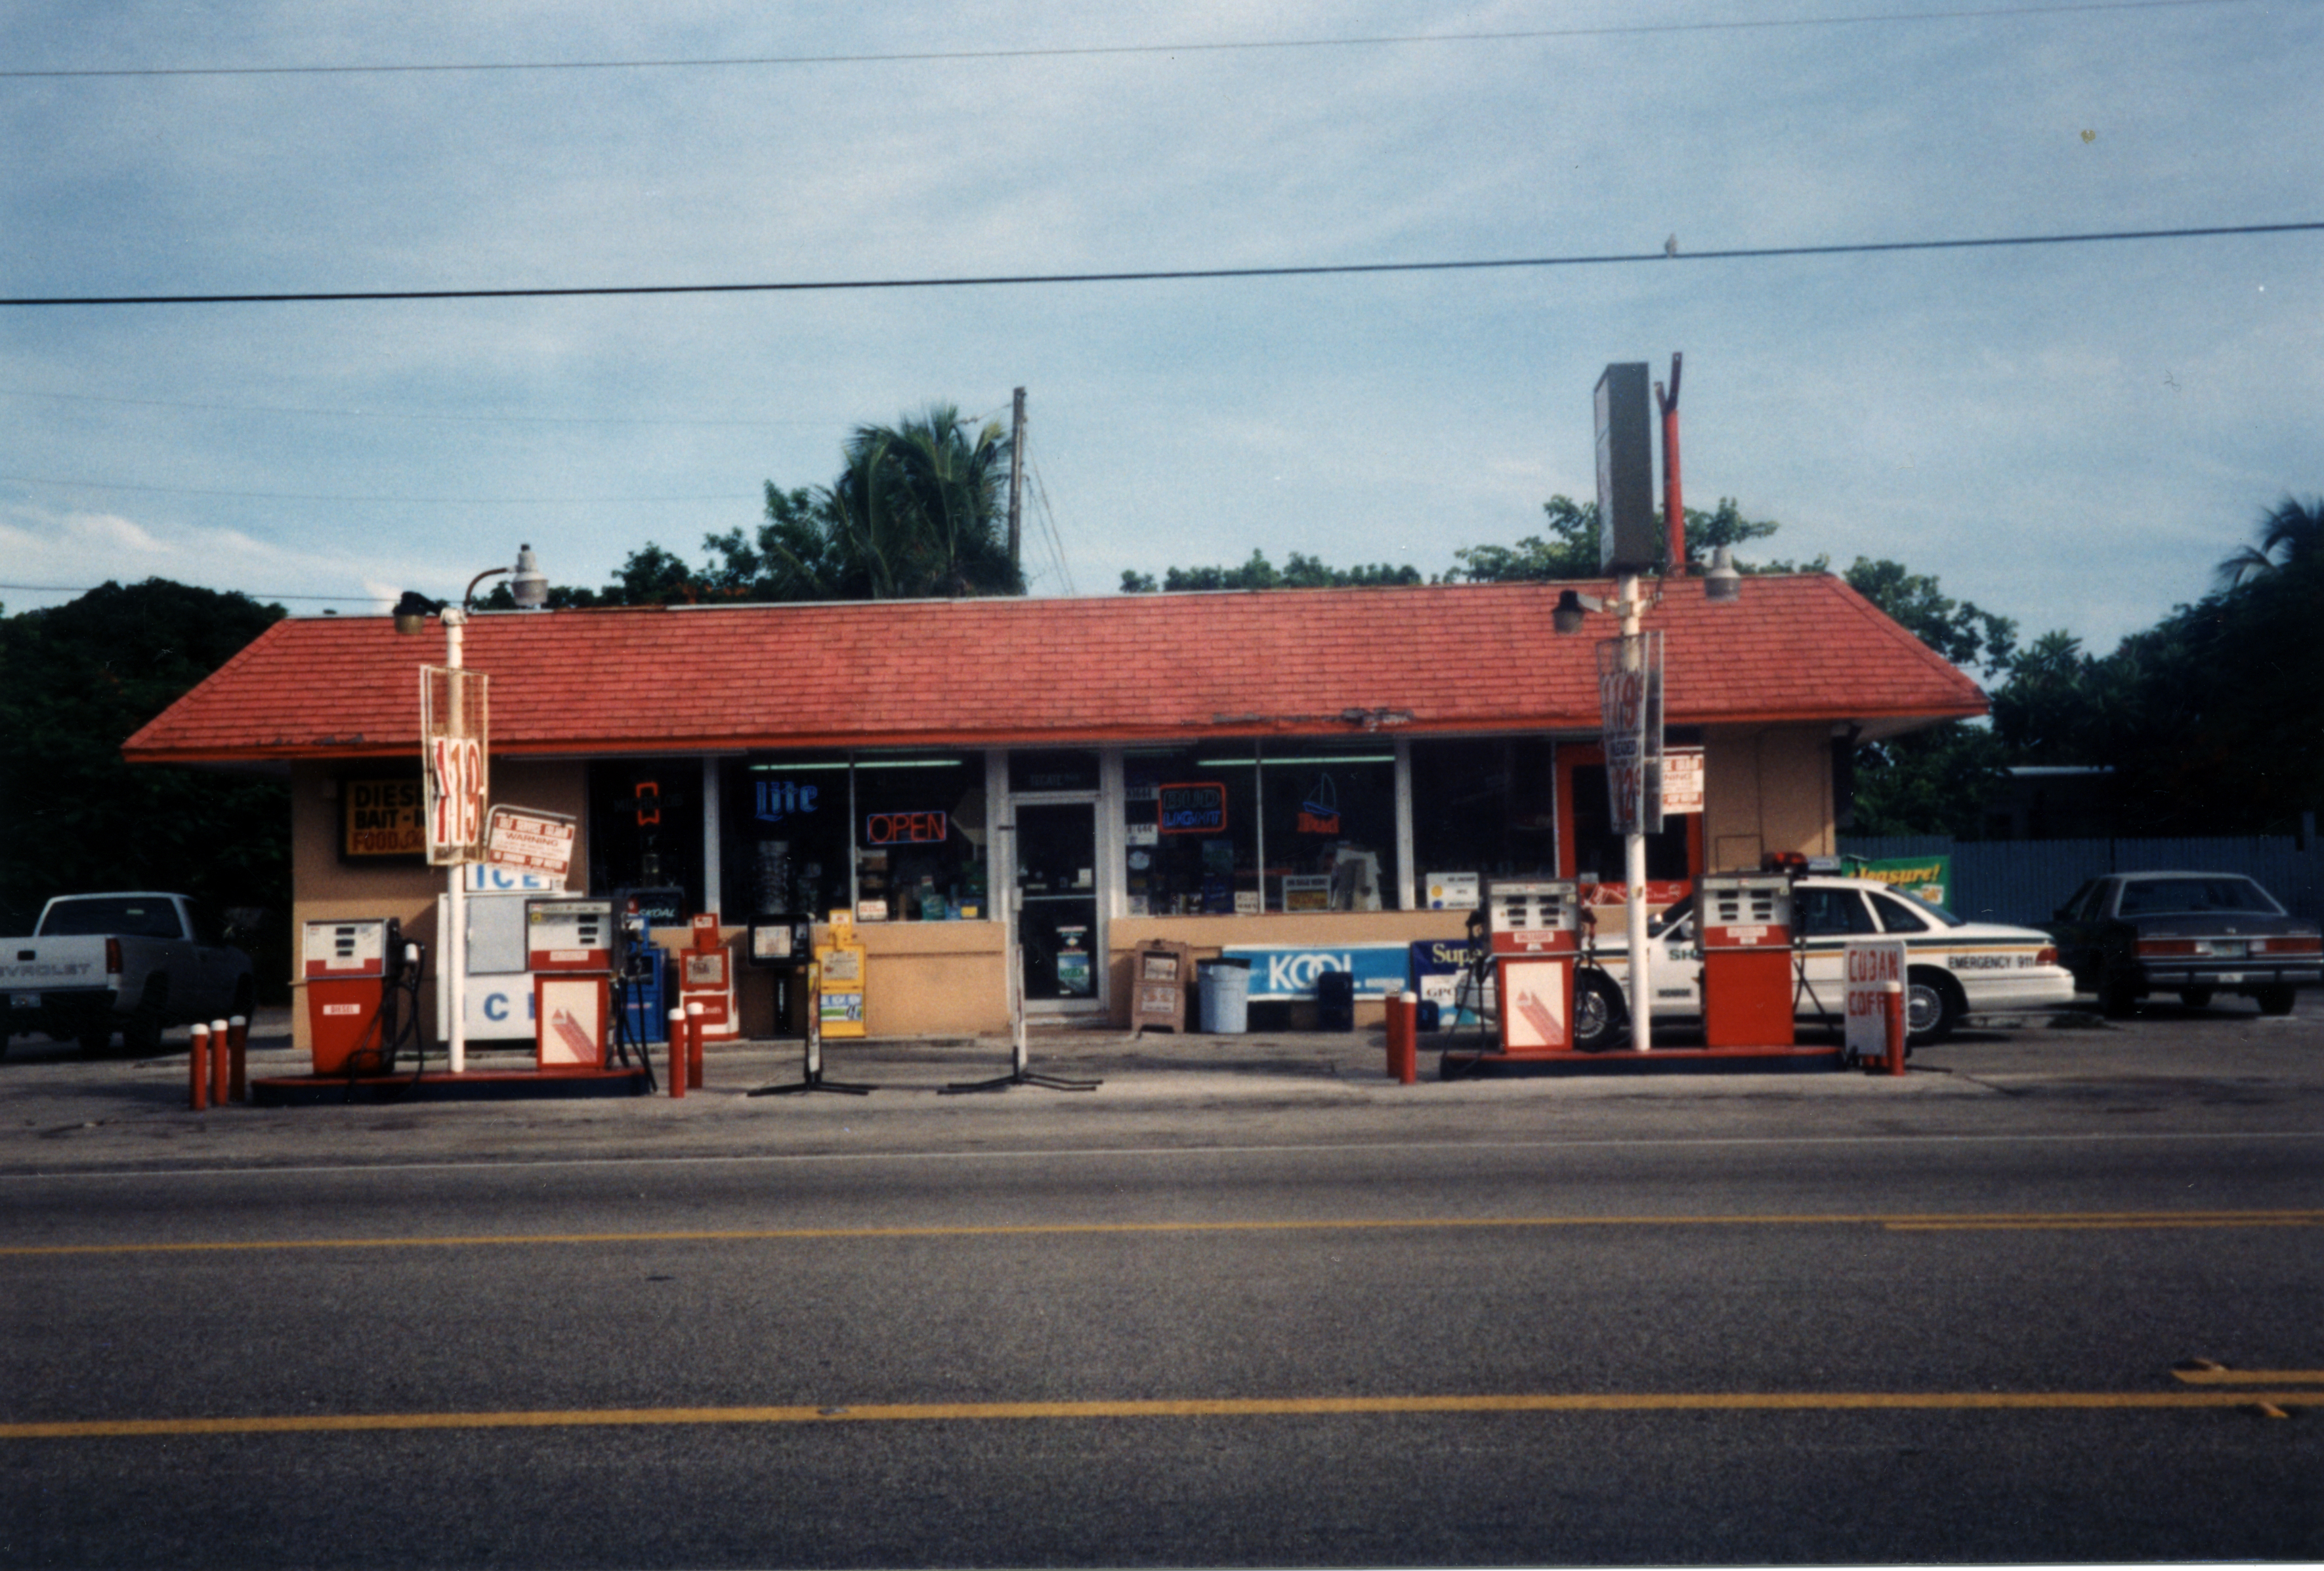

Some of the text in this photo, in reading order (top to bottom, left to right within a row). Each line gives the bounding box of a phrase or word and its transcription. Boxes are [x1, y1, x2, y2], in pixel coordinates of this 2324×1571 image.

[755, 782, 818, 821] Lite
[355, 809, 398, 829] BAIT
[869, 812, 945, 843] OPEN
[506, 831, 559, 847] WARNING
[1848, 862, 1941, 886] leasure!
[639, 907, 676, 918] SKOAL
[1269, 954, 1361, 990] KOOL
[1948, 955, 2011, 969] EMERGENCY
